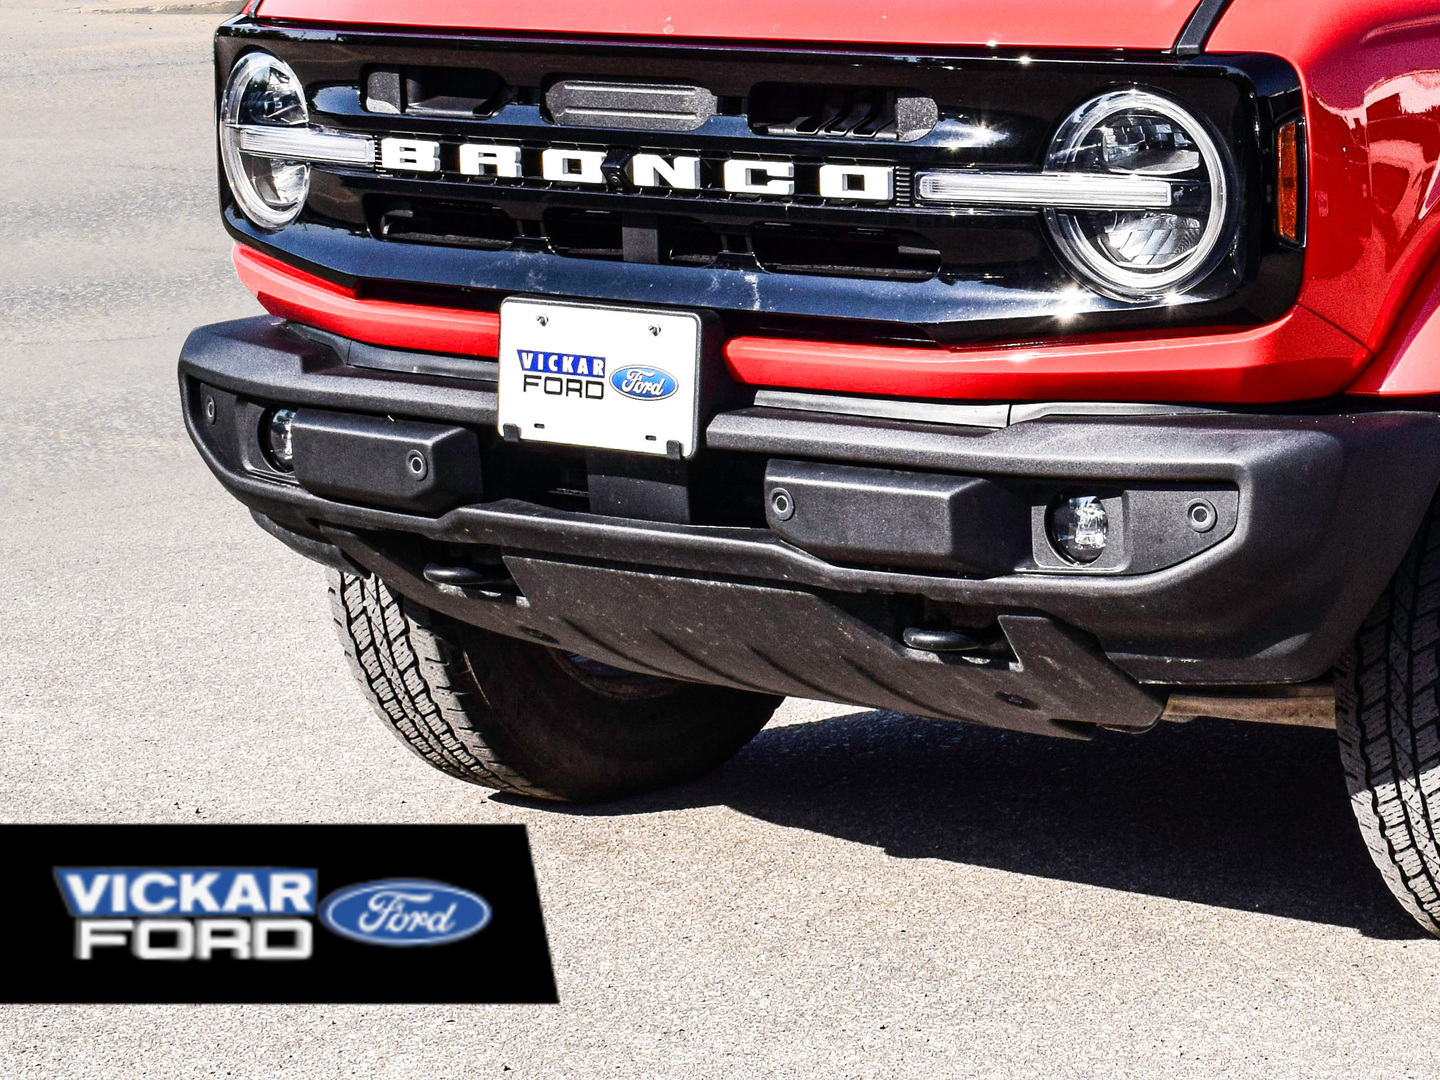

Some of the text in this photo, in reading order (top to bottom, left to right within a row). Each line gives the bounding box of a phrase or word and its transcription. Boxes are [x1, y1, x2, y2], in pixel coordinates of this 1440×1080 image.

[381, 137, 894, 201] BRONCO
[520, 350, 606, 378] VICKAR
[523, 376, 604, 400] FORD
[620, 369, 665, 397] Ford
